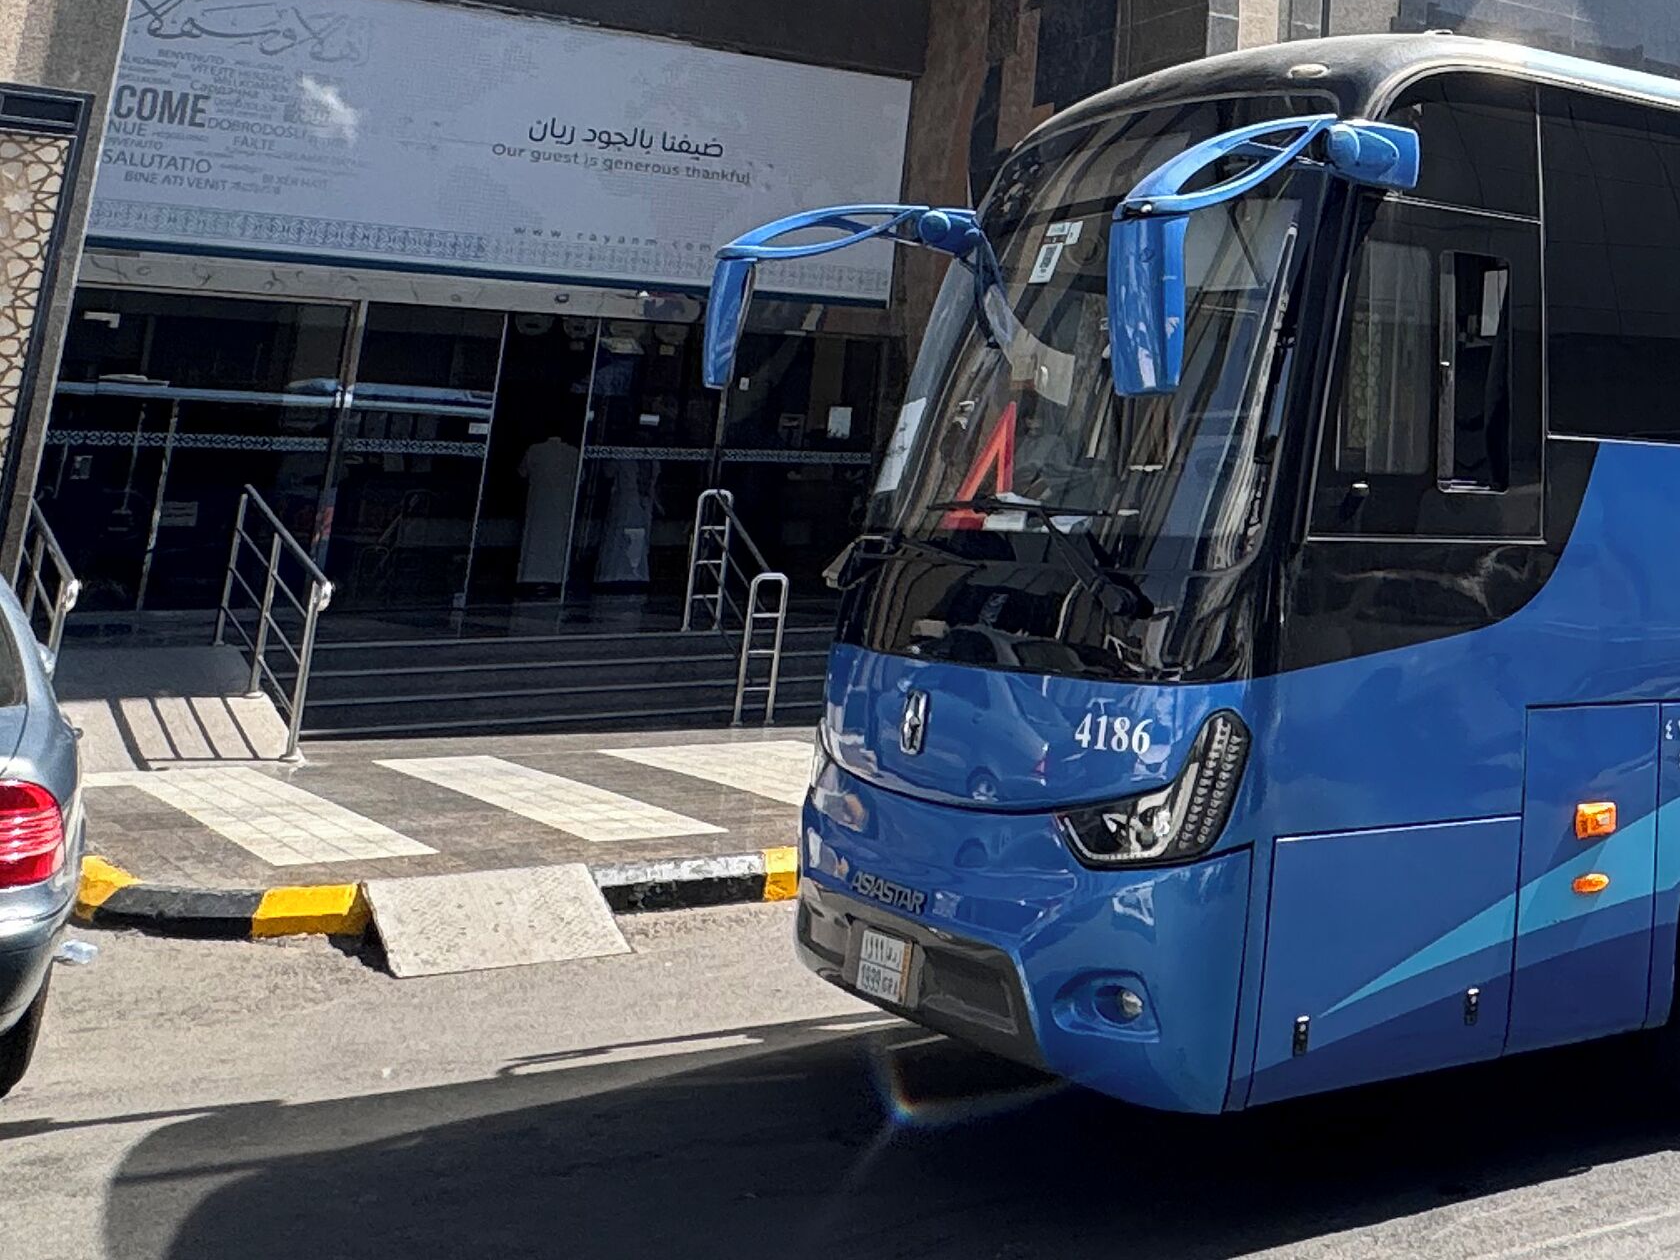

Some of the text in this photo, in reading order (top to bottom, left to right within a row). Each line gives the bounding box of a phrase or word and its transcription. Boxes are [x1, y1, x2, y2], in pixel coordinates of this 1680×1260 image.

[113, 84, 212, 129] COME
[101, 148, 213, 174] SALUTATIO
[528, 117, 724, 161] ضيفنا بالجود ريان
[491, 142, 526, 158] Our
[530, 148, 580, 166] guest
[602, 158, 680, 178] generous
[685, 164, 751, 186] thankful
[1074, 712, 1154, 755] 4186
[850, 871, 926, 915] ASIASTAR
